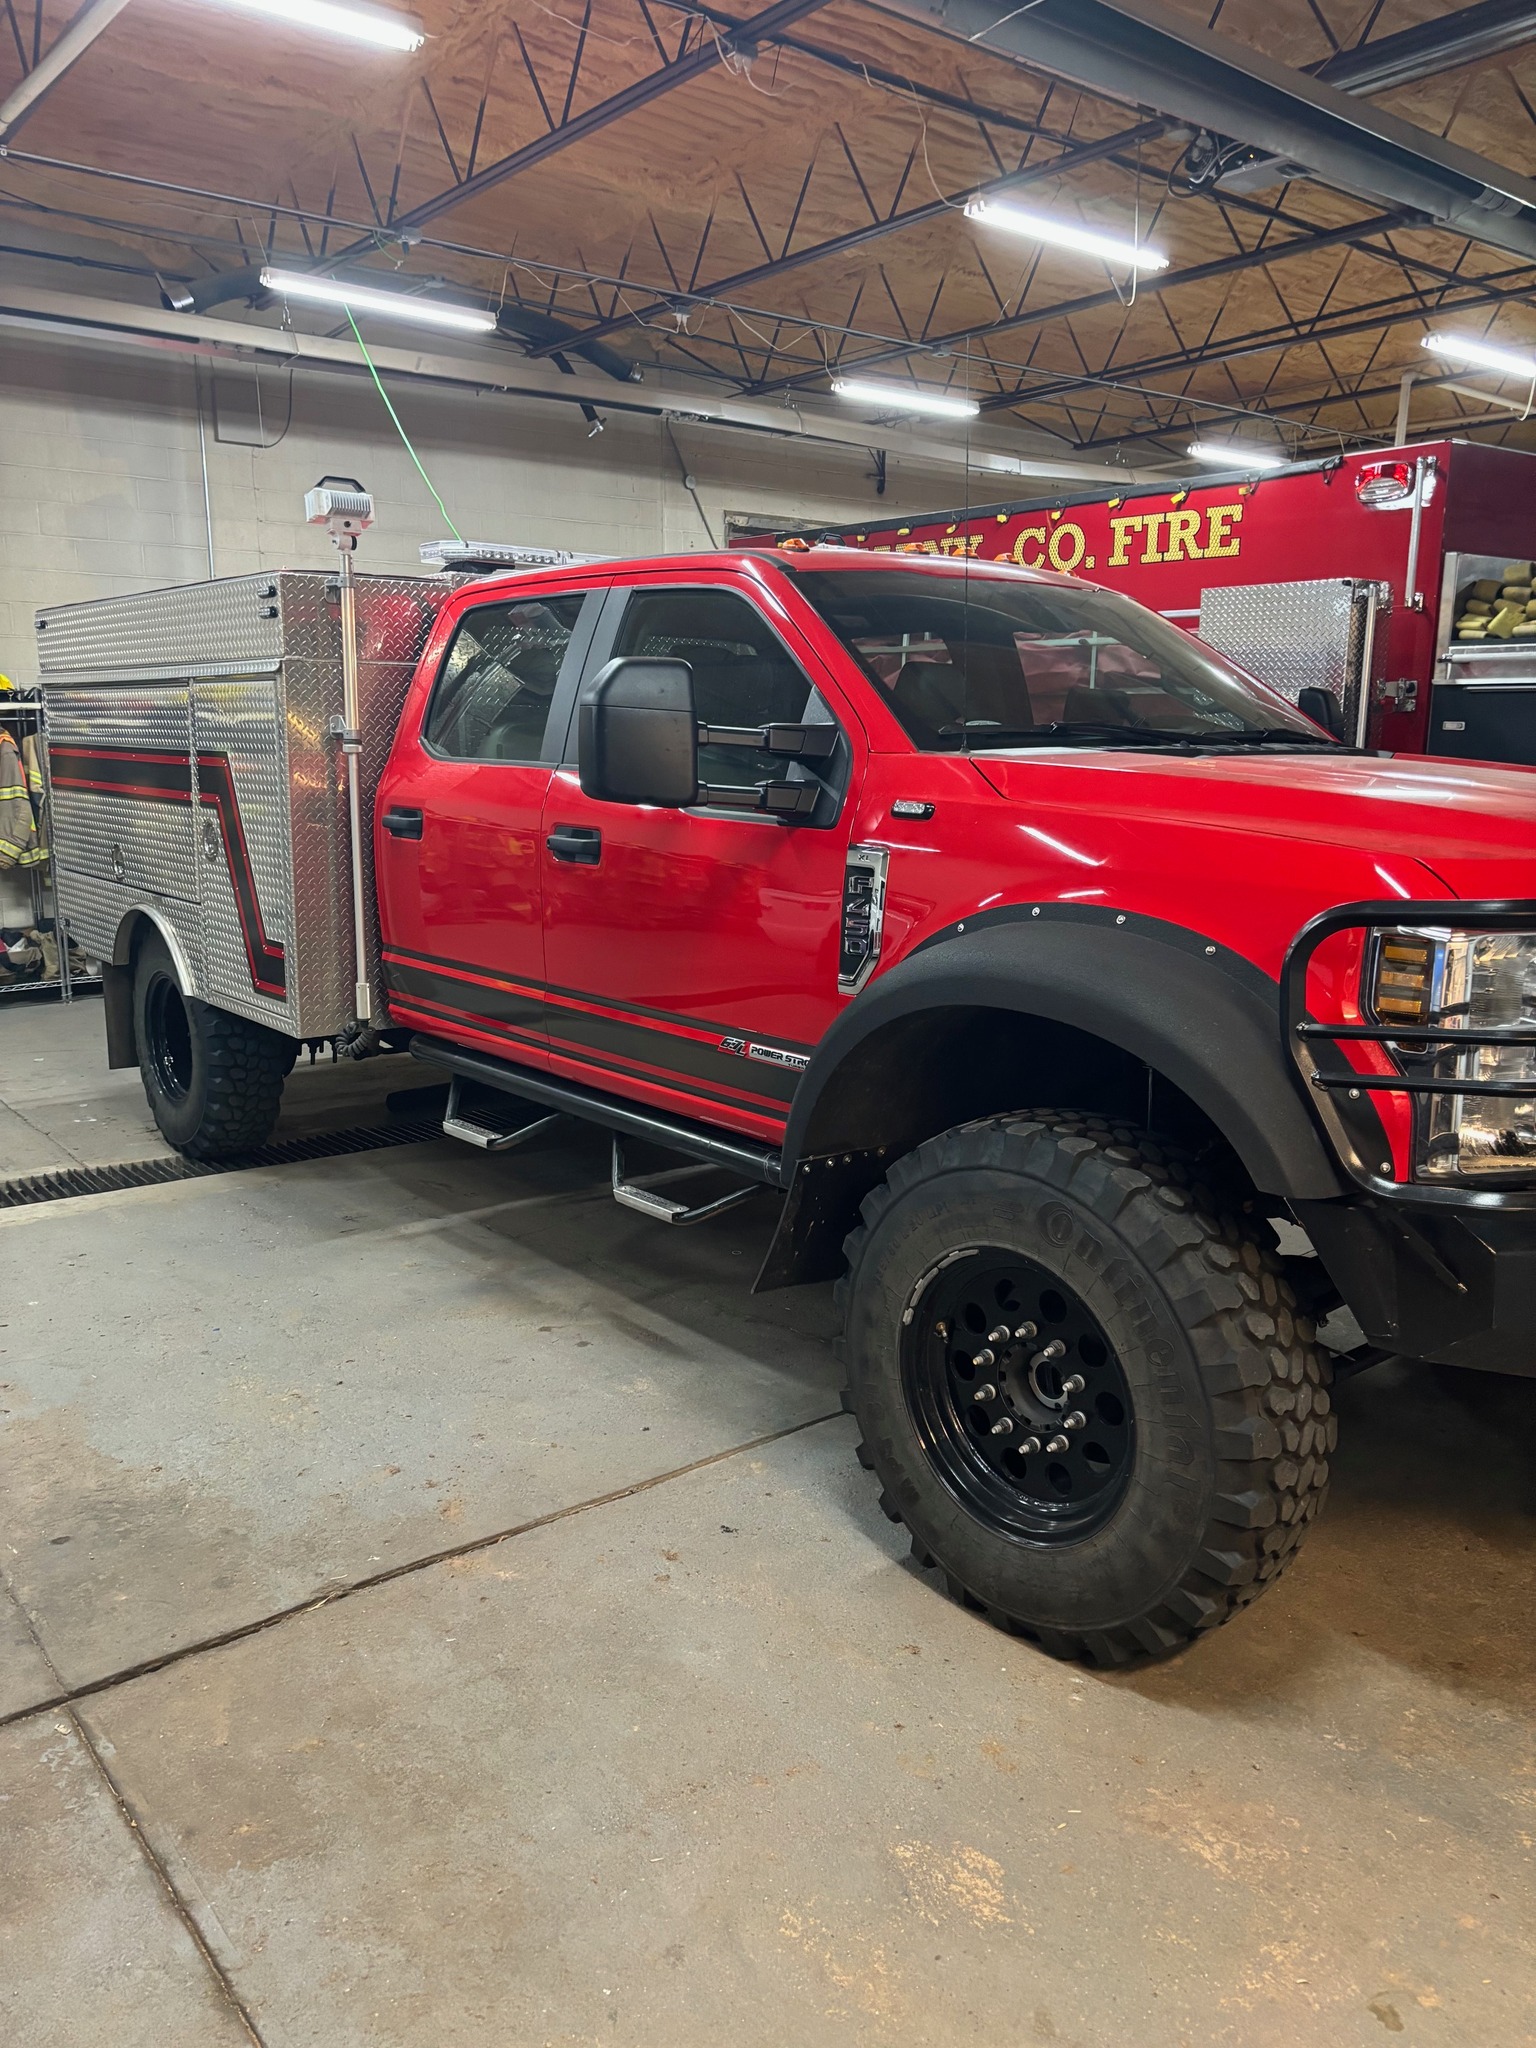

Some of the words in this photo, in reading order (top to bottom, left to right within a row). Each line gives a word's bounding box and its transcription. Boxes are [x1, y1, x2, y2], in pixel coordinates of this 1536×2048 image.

[1013, 522, 1096, 570] CO.
[1107, 504, 1243, 567] FIRE
[858, 854, 872, 863] XL
[751, 1046, 783, 1060] POWER
